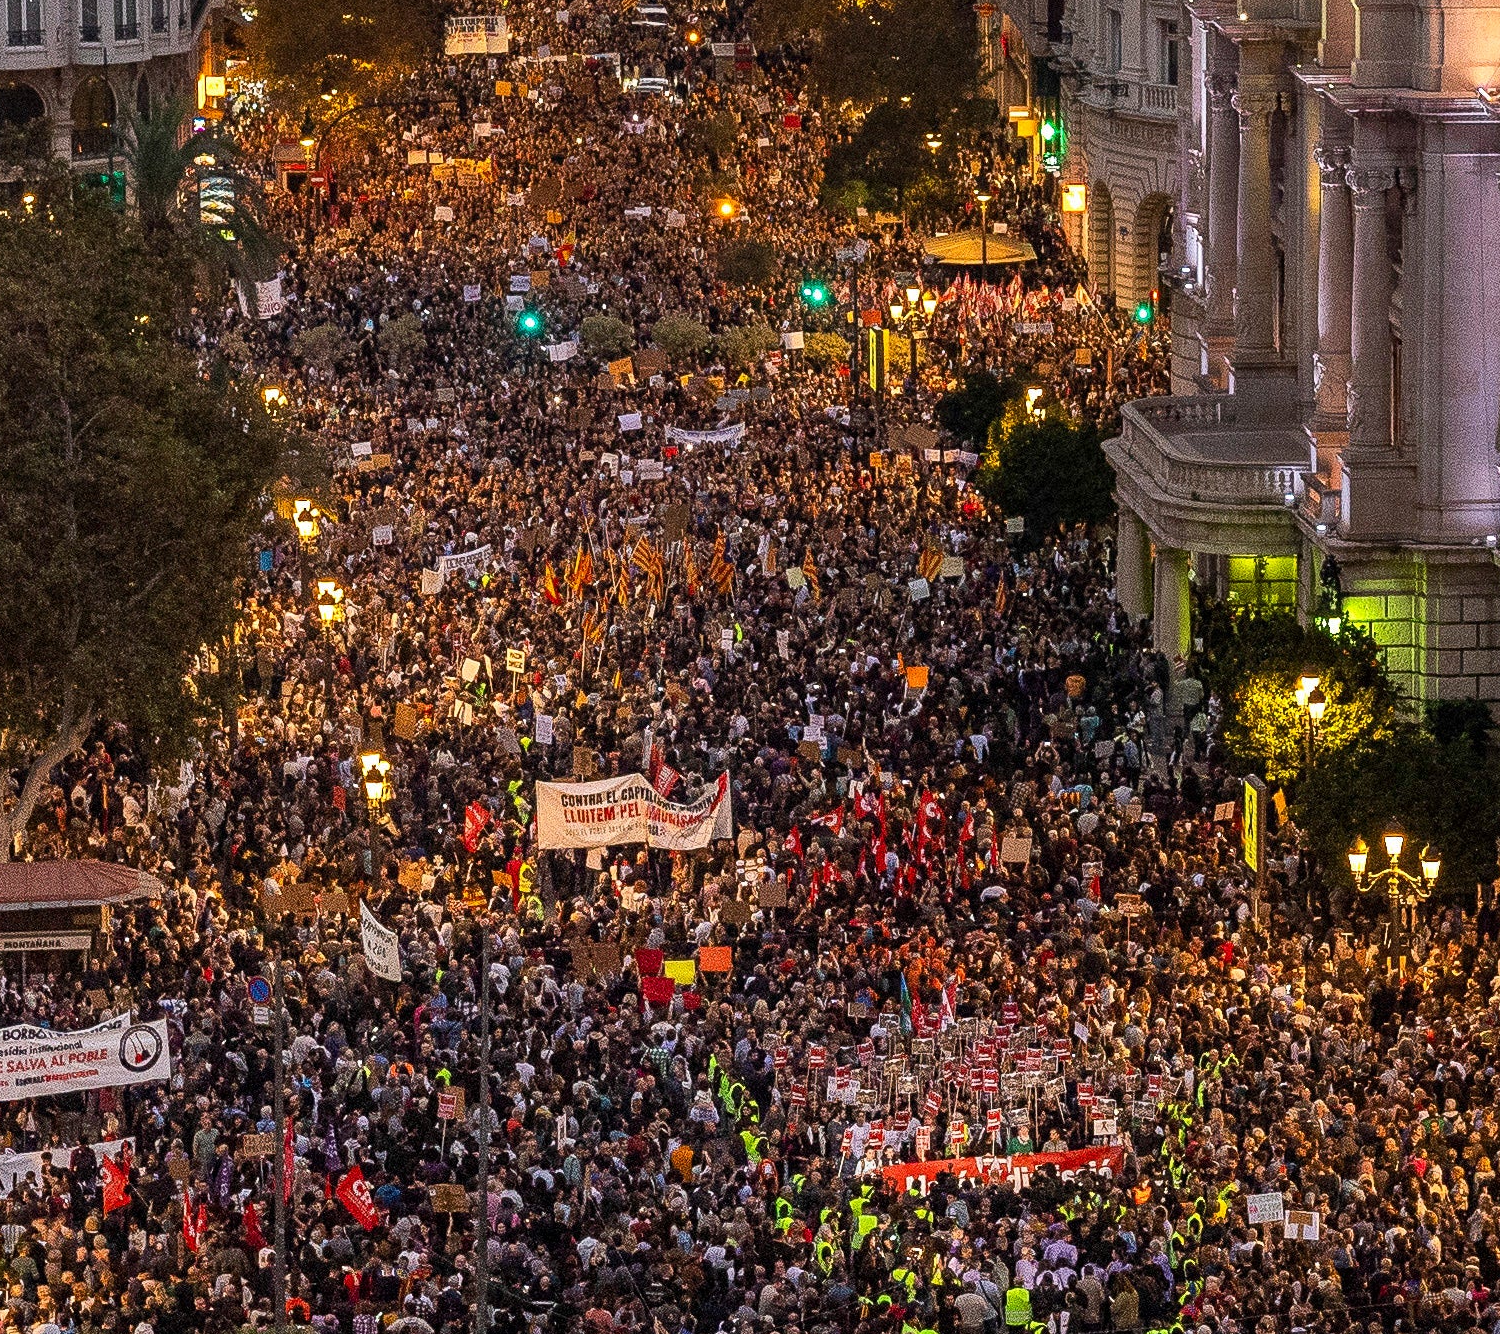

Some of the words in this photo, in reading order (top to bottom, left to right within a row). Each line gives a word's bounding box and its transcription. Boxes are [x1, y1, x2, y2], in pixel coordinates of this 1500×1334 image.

[561, 792, 603, 808] CONTRA
[606, 791, 619, 804] EL
[564, 806, 615, 824] LLUITEM
[6, 1059, 47, 1073] SALVA
[68, 1049, 108, 1065] POBLE
